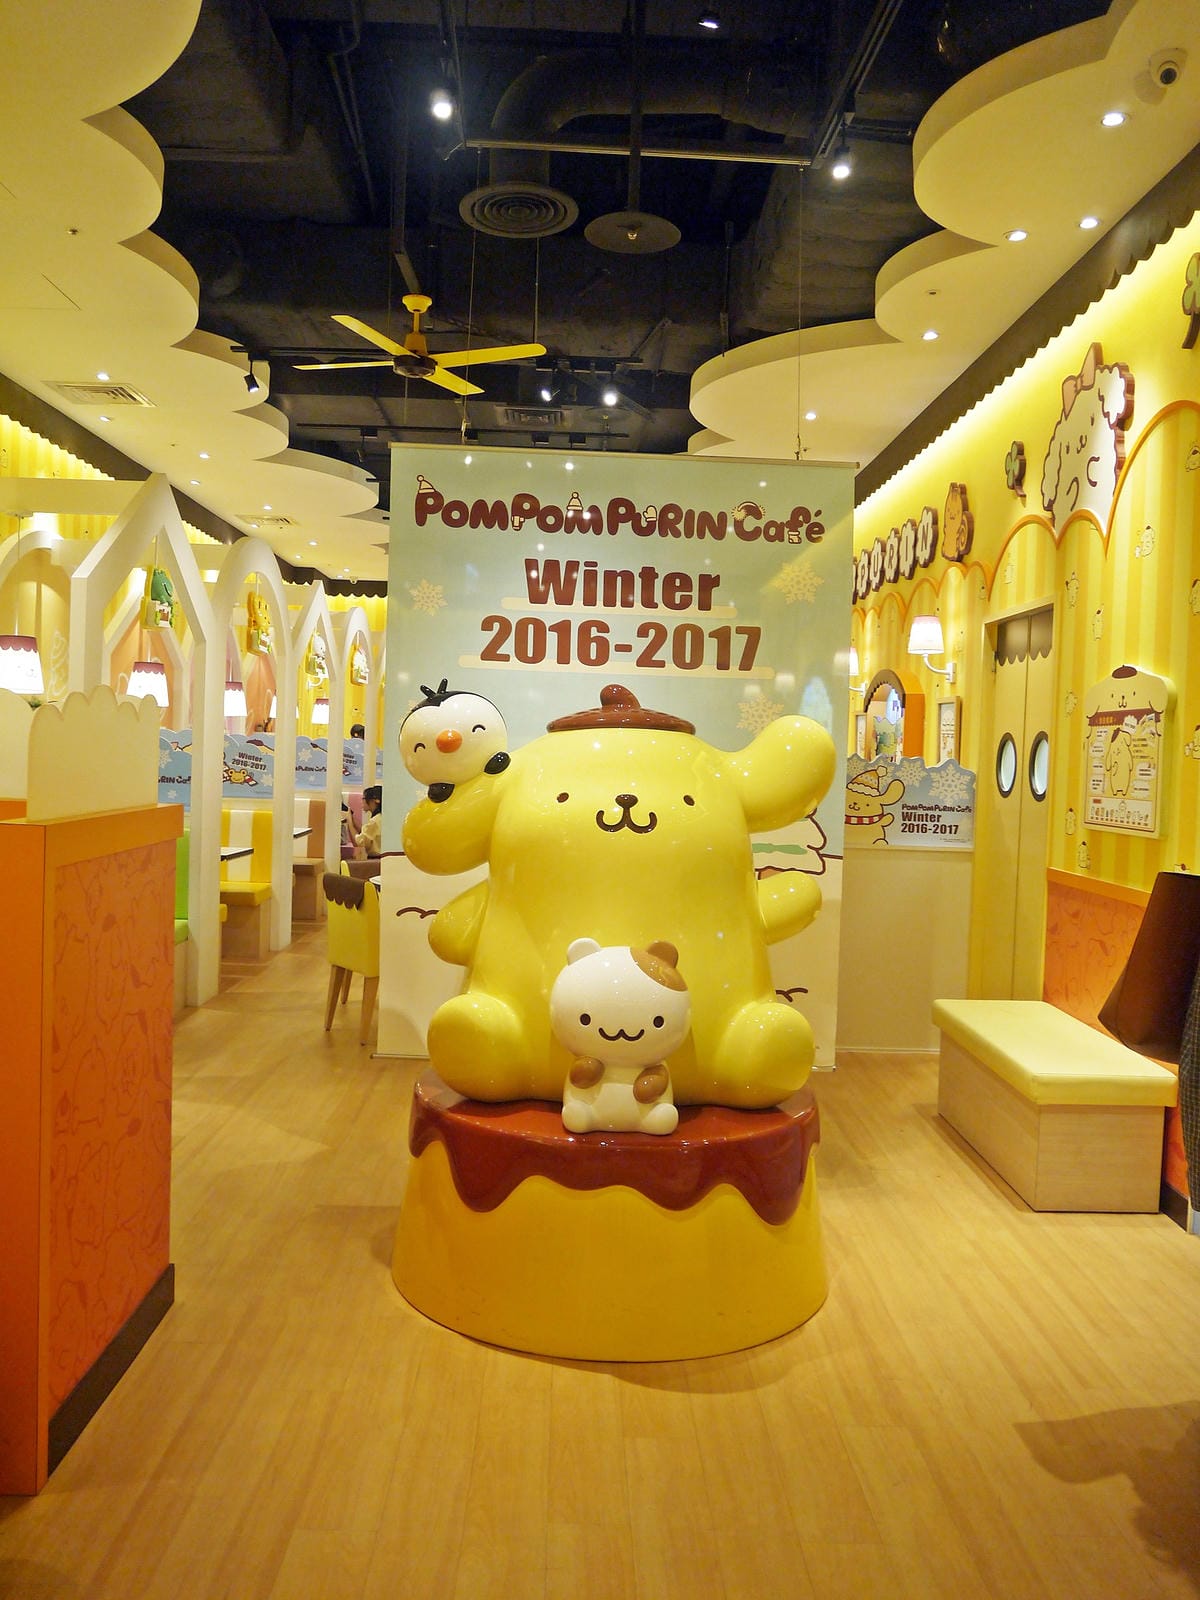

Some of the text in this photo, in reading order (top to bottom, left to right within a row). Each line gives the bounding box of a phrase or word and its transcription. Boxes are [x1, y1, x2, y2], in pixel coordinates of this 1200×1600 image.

[733, 500, 826, 545] Café
[524, 557, 721, 612] Winter
[480, 615, 762, 671] 2016-2017
[231, 758, 267, 770] 2016-2017
[238, 752, 263, 763] Winter
[901, 811, 943, 823] Winter
[900, 822, 960, 835] 2016-2017
